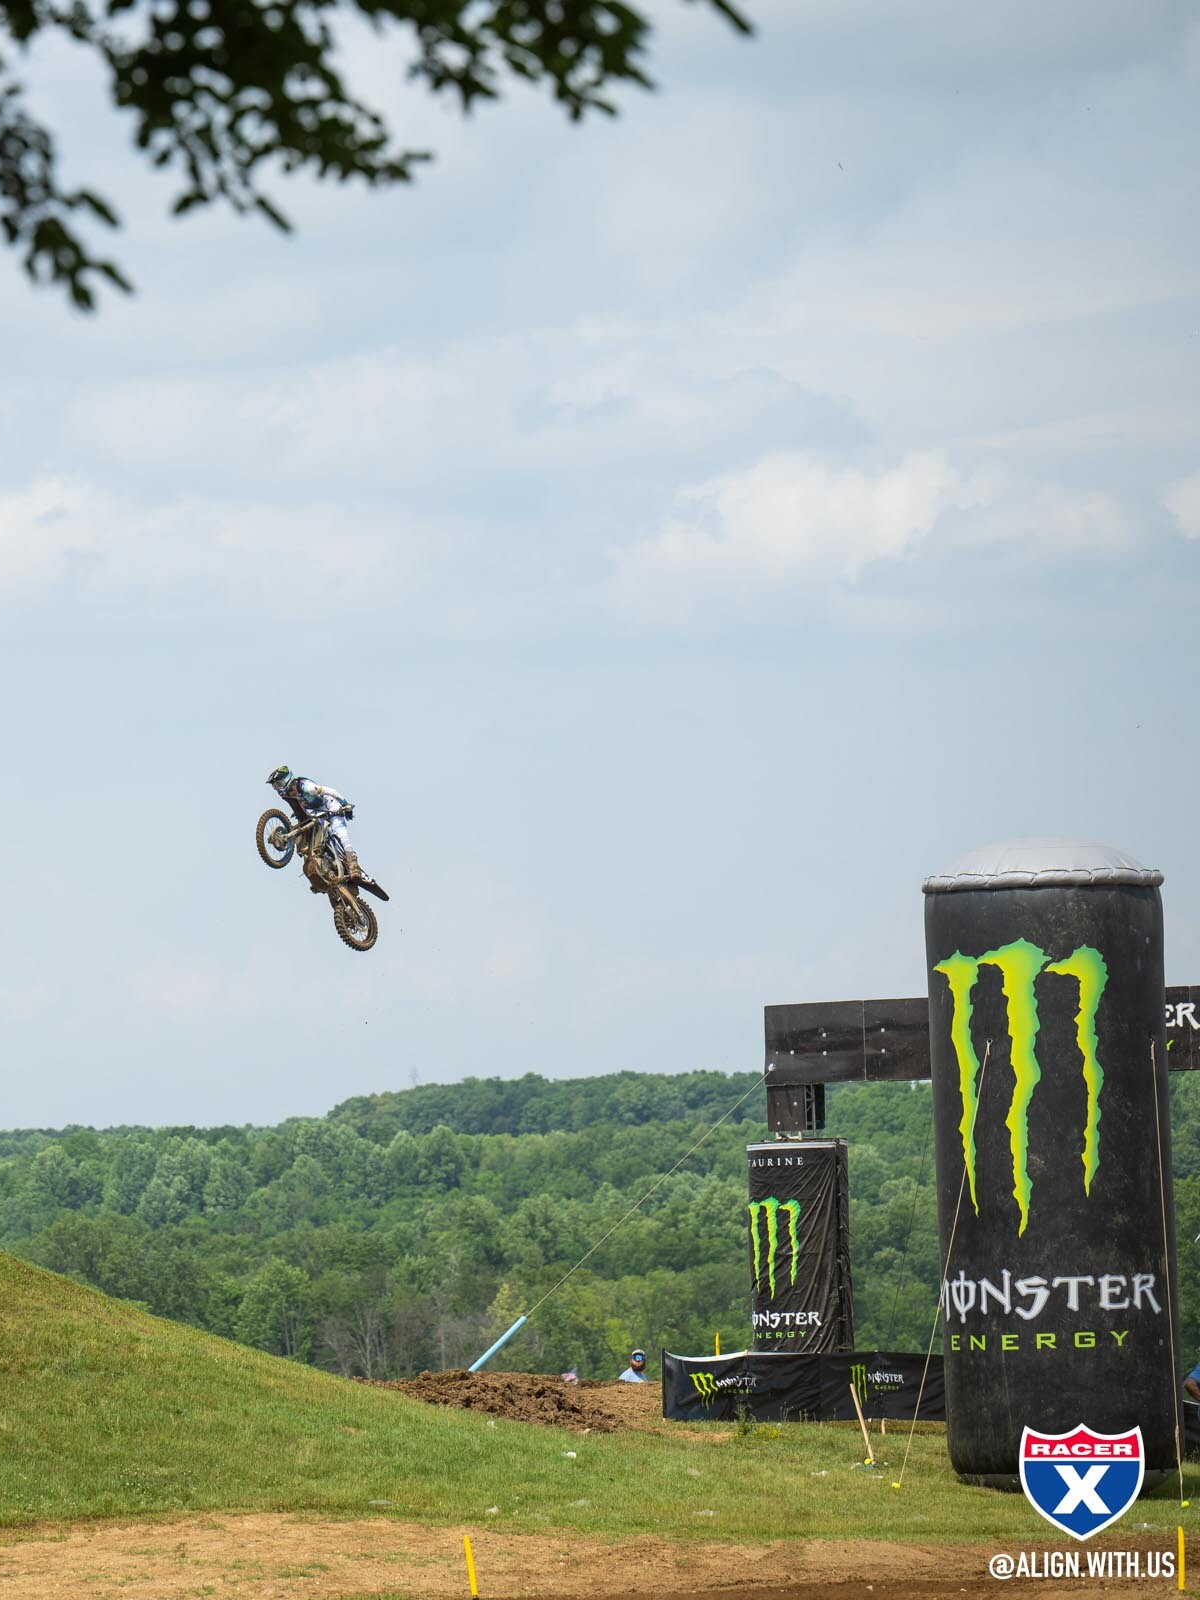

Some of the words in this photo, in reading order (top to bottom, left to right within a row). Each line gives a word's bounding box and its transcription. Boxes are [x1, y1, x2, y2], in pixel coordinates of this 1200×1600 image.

[748, 1156, 804, 1168] TAURINE
[752, 1309, 822, 1330] ONSTER
[754, 1330, 807, 1339] NERGY
[951, 1330, 1129, 1351] ENERGY
